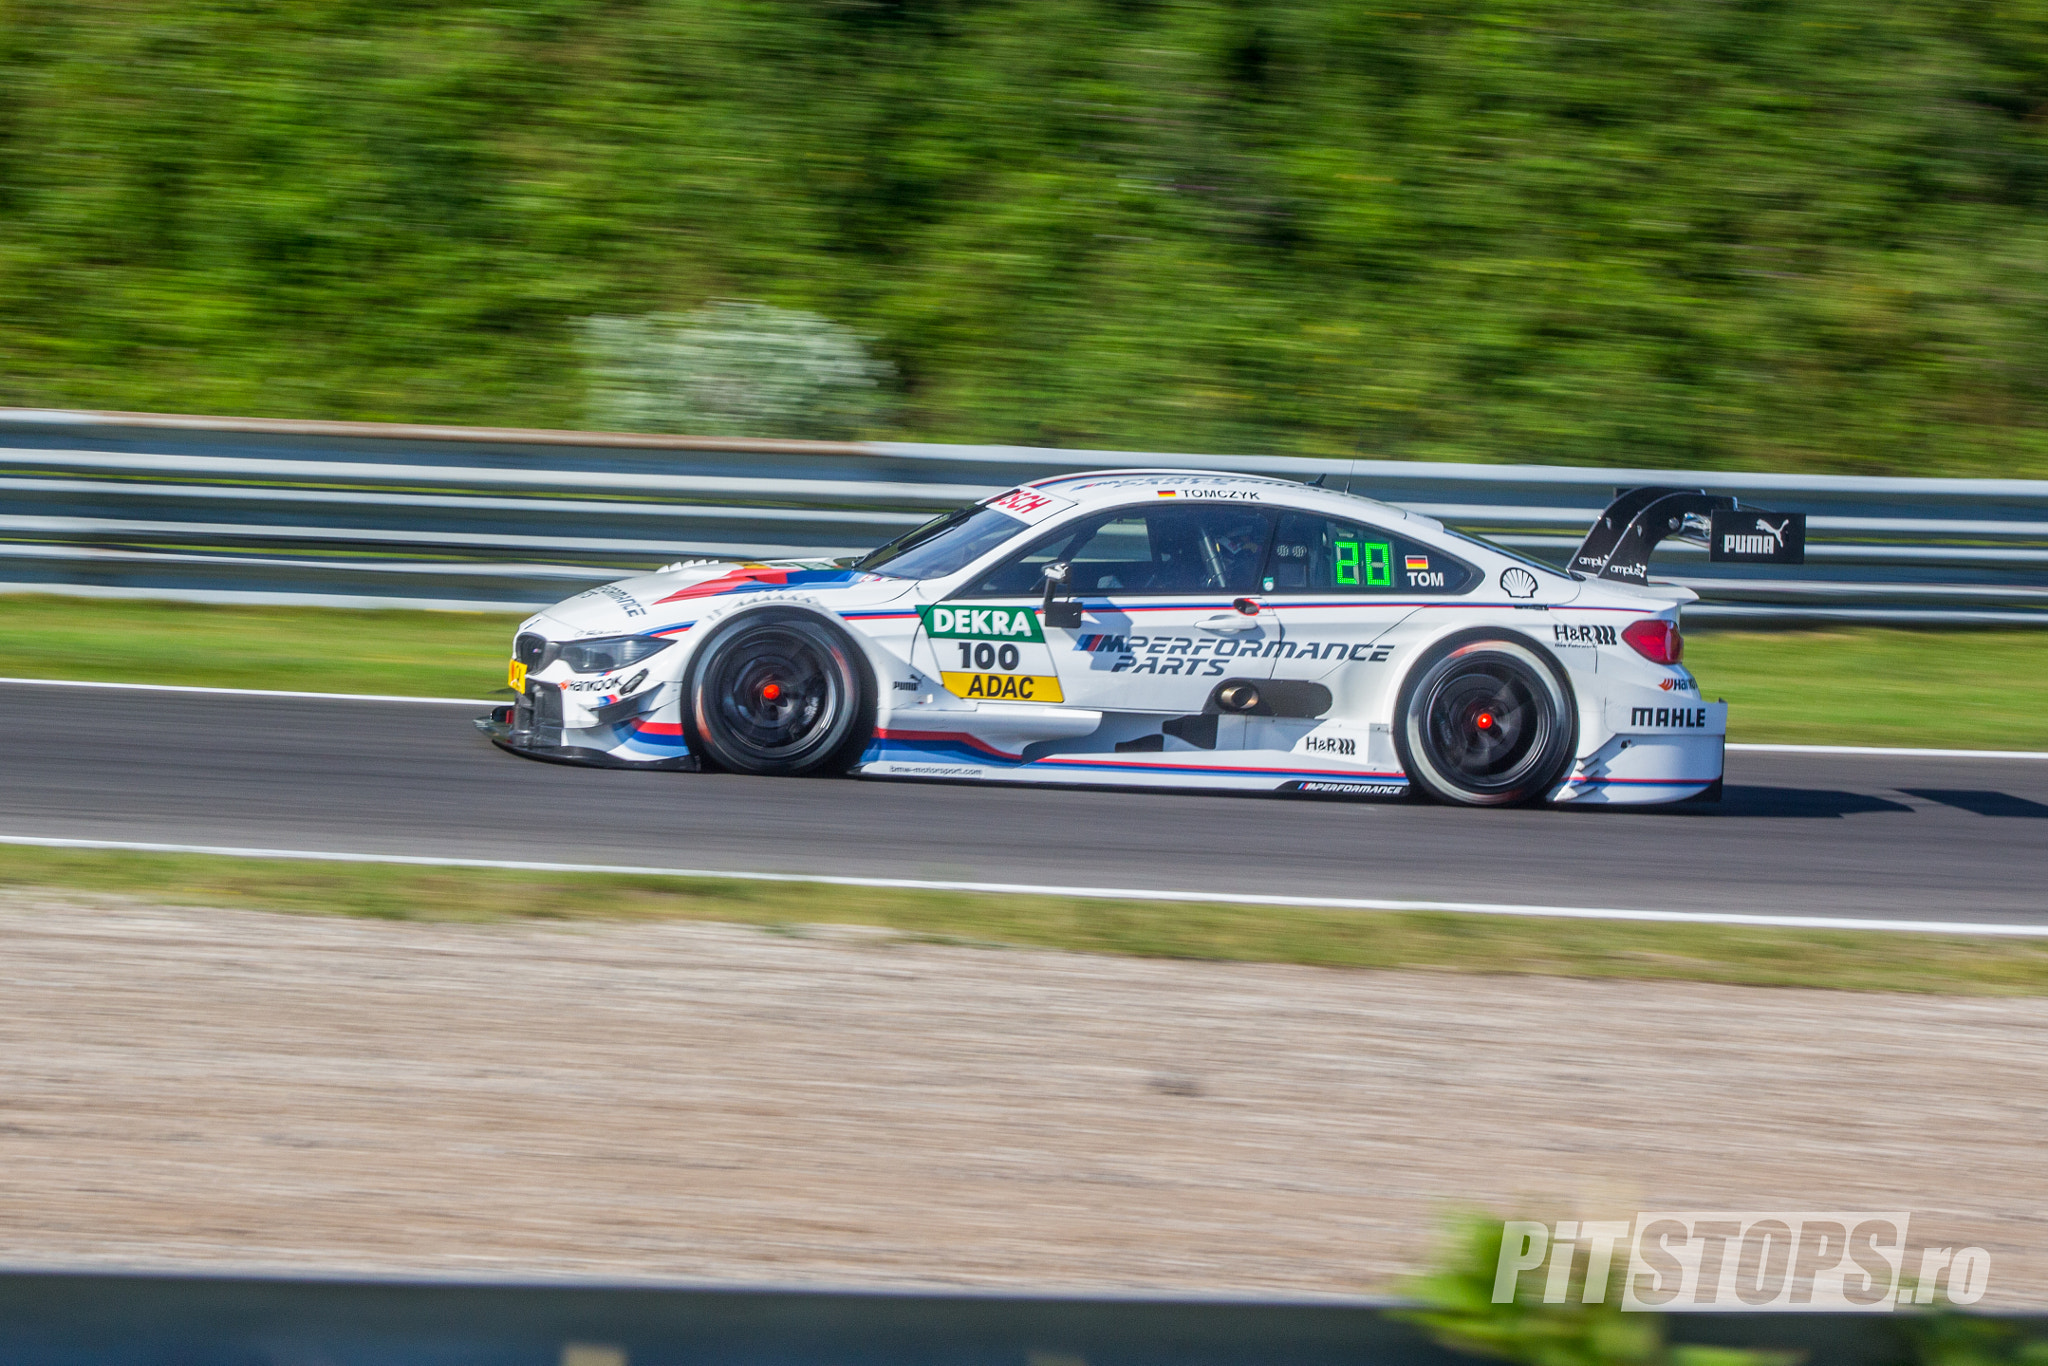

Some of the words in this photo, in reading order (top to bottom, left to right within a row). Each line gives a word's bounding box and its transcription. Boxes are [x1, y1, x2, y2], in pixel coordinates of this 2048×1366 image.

[1180, 489, 1261, 501] TOMCZYK
[1723, 534, 1774, 554] PUMA
[1407, 572, 1444, 587] TOM
[933, 608, 1032, 637] DEKRA
[958, 642, 1019, 670] 100
[1111, 656, 1230, 676] PARTS
[967, 675, 1034, 699] ADAC
[1631, 707, 1706, 728] MAHLE
